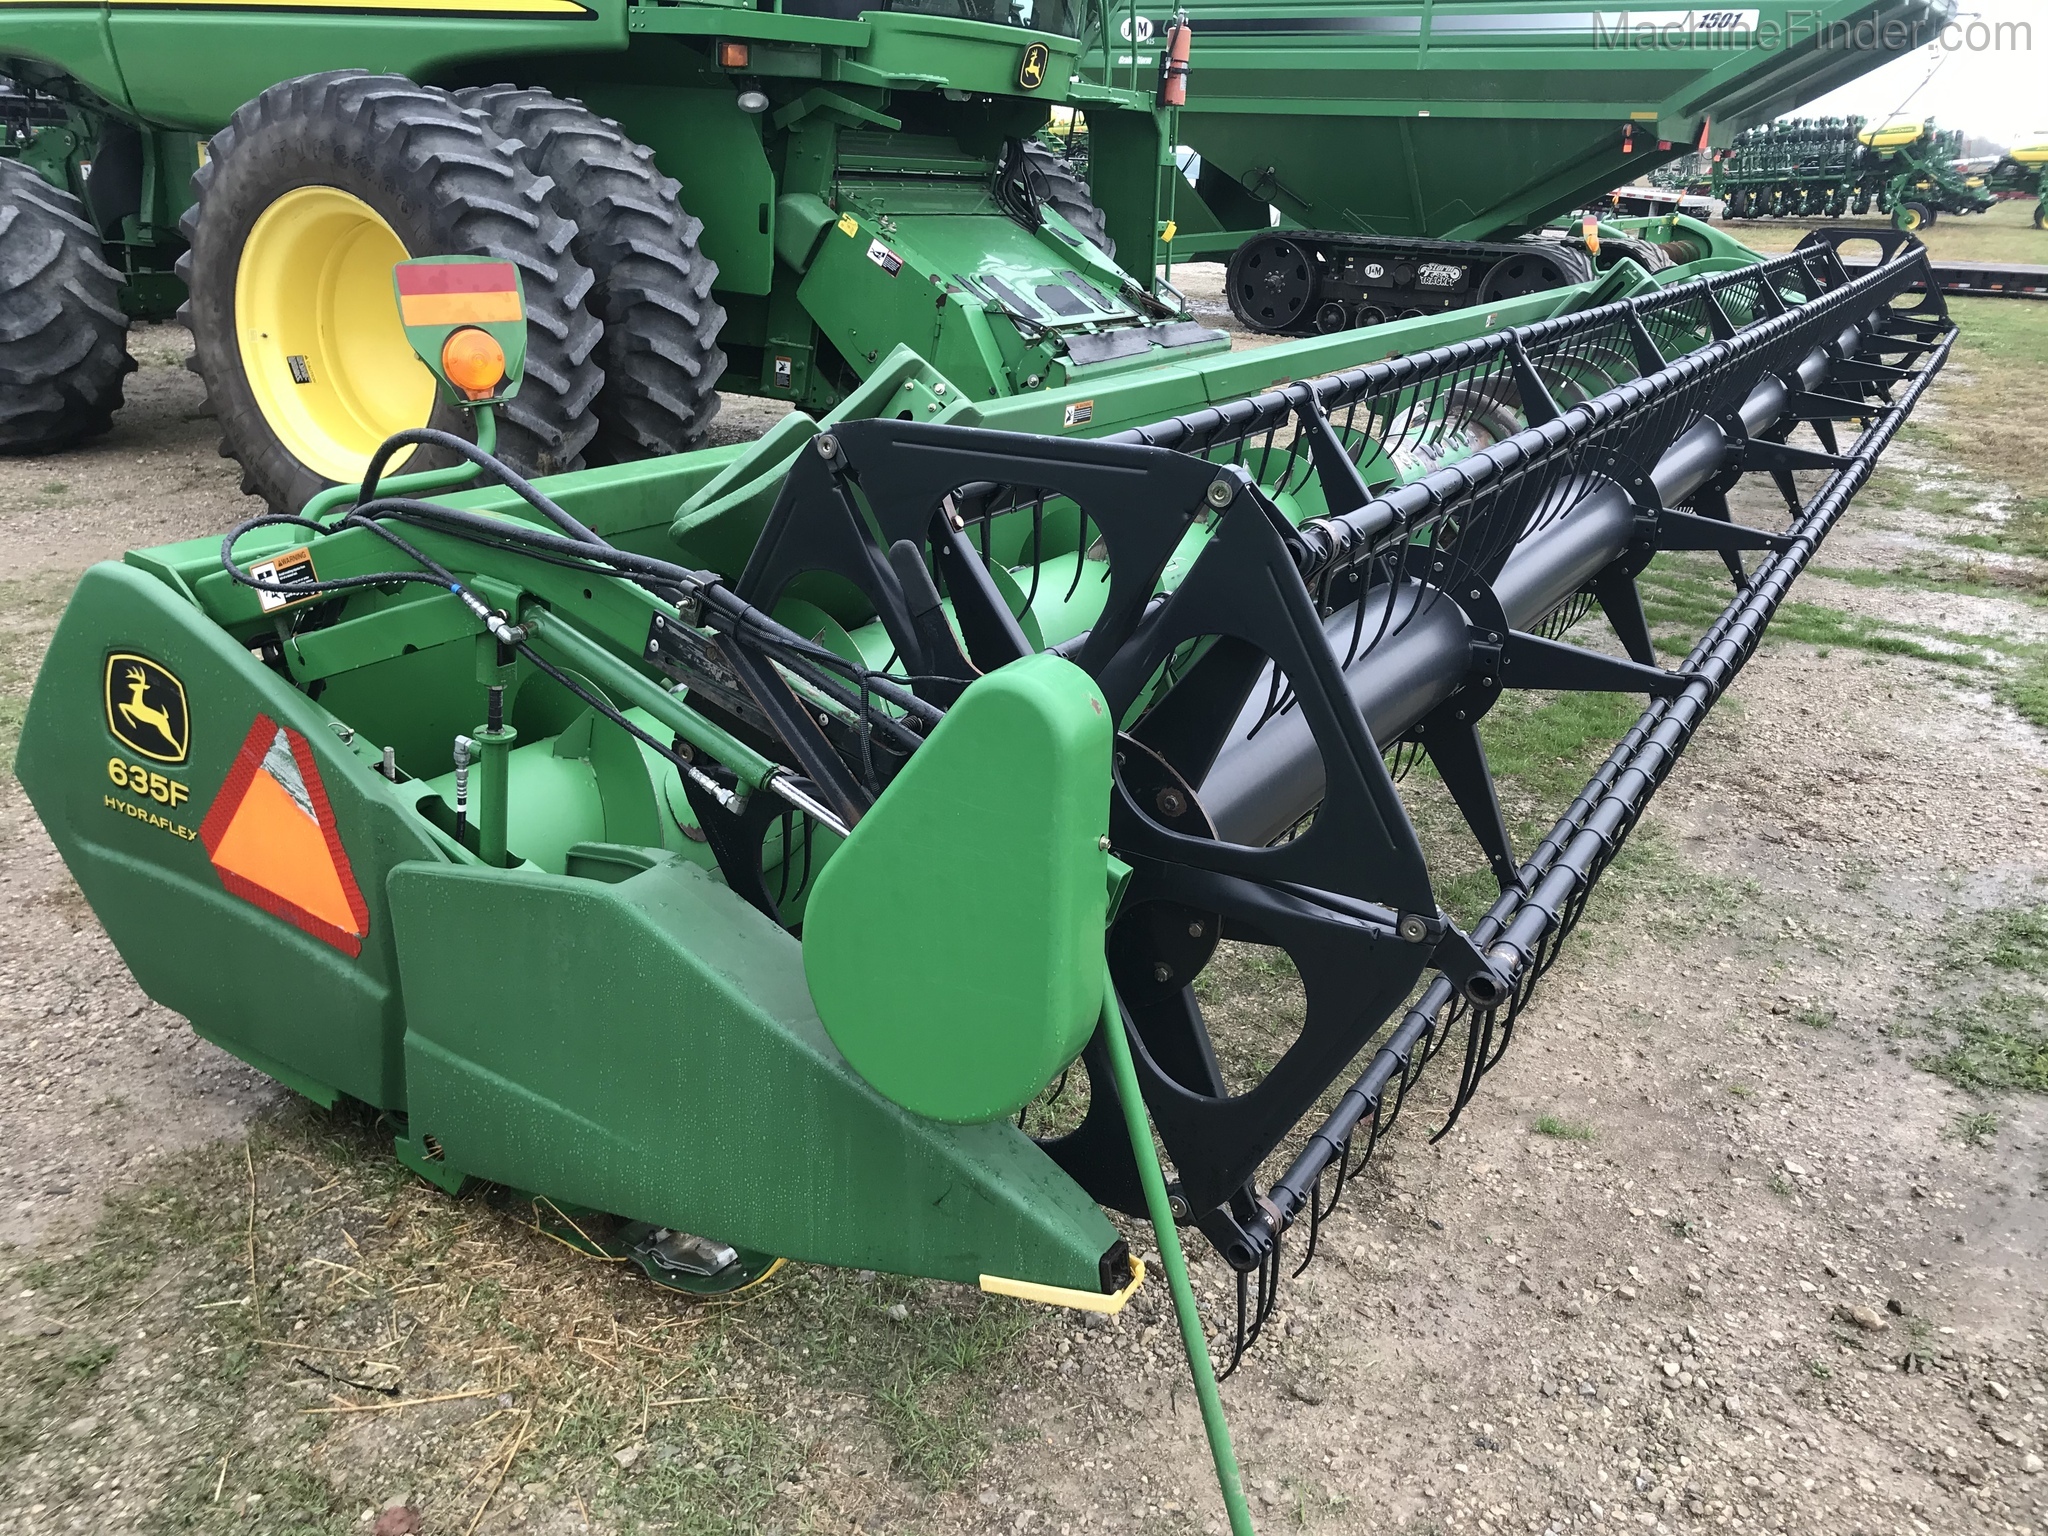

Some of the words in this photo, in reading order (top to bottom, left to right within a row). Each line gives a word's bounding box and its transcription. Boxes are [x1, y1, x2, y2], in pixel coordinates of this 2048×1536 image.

[1123, 21, 1148, 37] JM
[1700, 12, 1744, 29] 1501
[281, 551, 307, 565] WARNING
[108, 757, 190, 808] 635F
[104, 794, 197, 841] HYDRAFLEX
